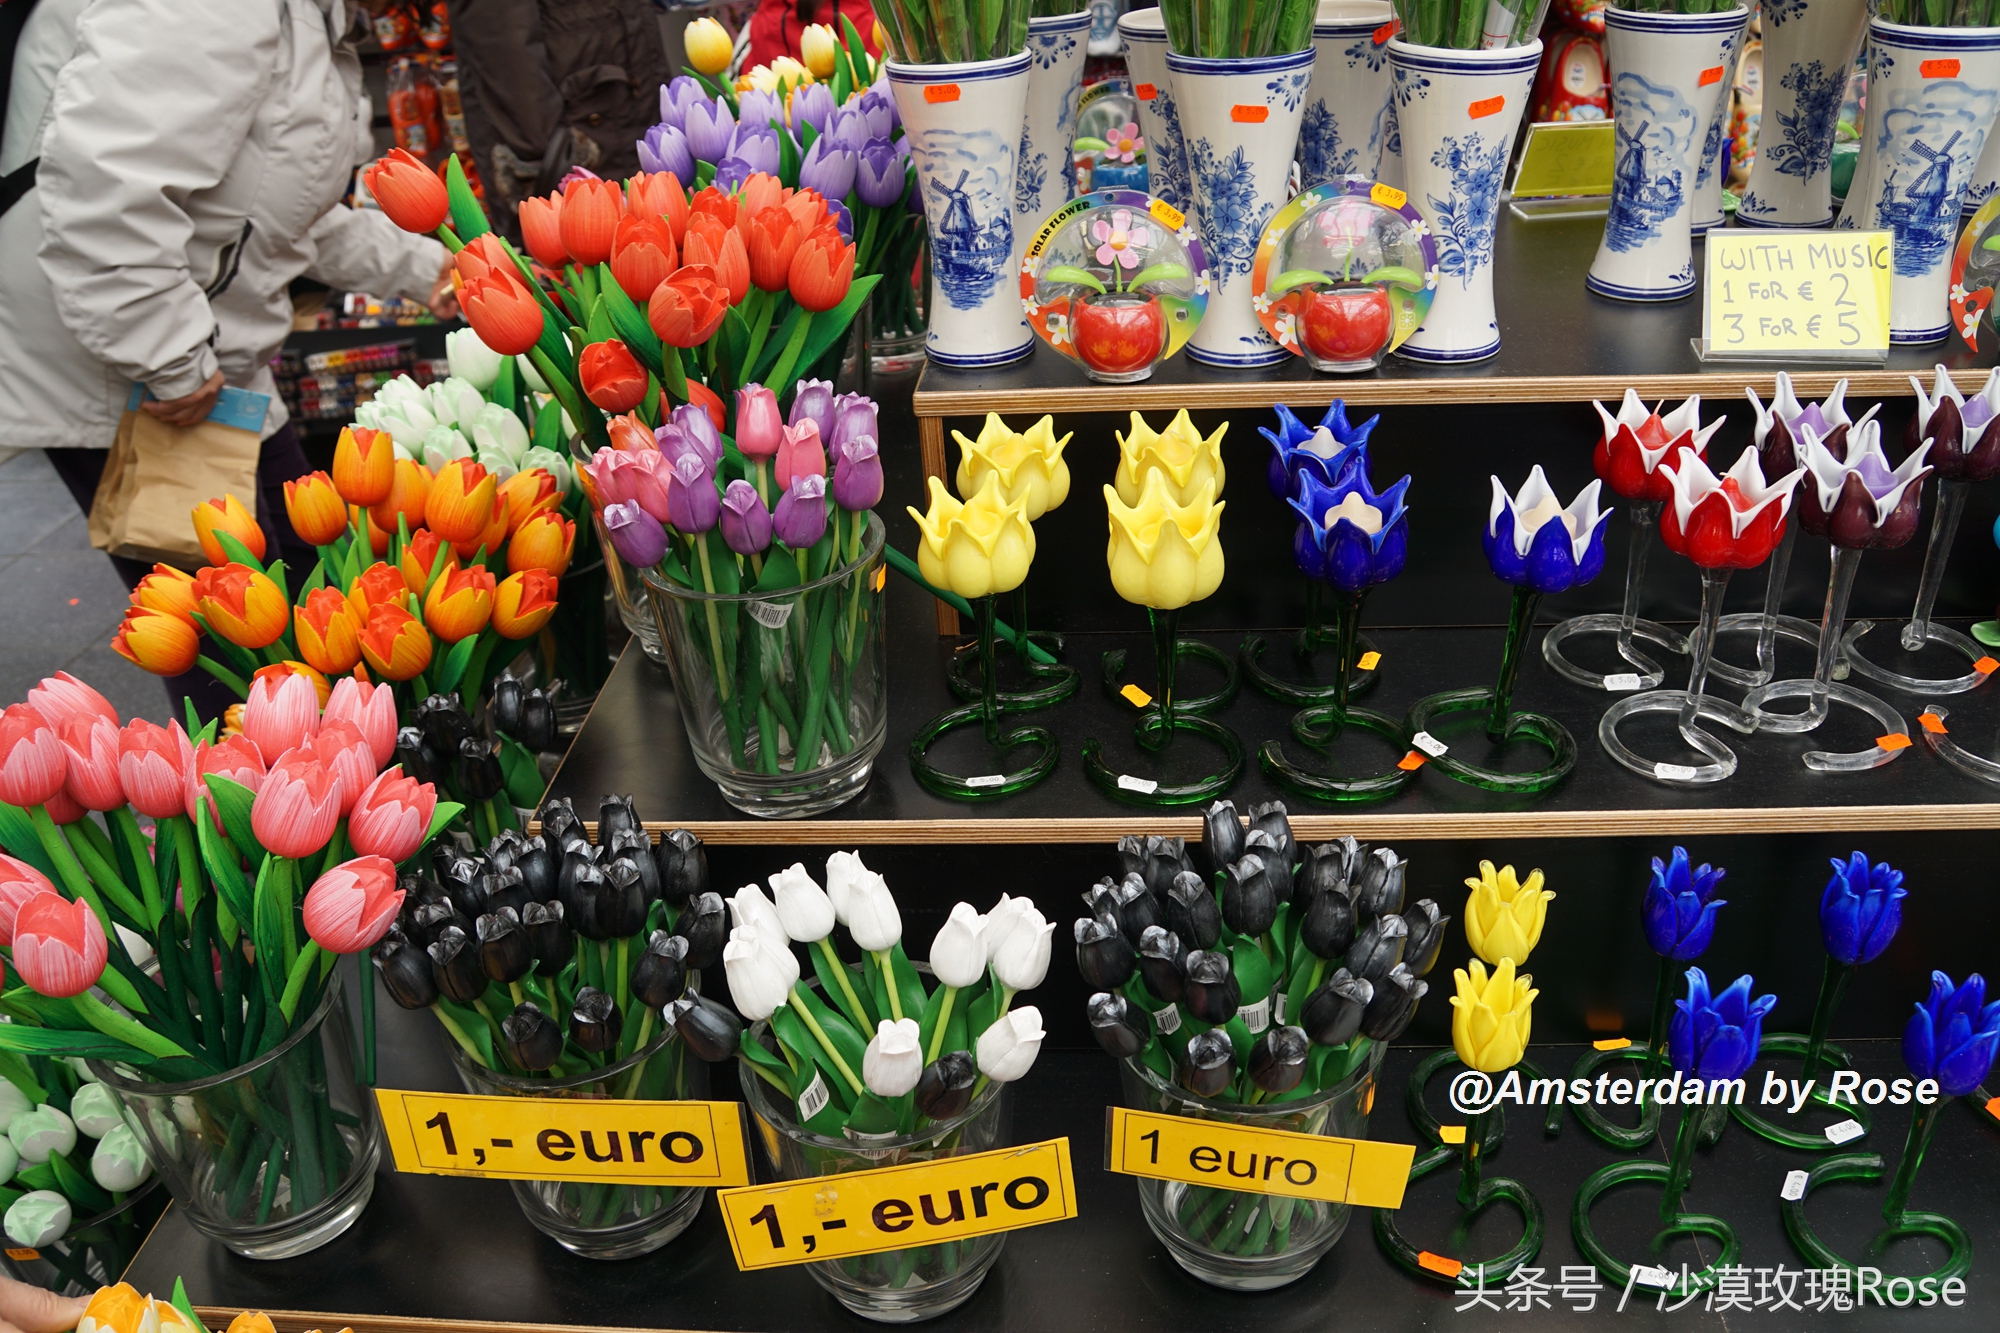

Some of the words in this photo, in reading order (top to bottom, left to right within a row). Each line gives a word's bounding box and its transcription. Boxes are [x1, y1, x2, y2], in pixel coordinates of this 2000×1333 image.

[1937, 61, 1957, 69] 5.00
[1082, 85, 1111, 104] FLOWER
[1246, 107, 1264, 115] 5.00
[1484, 98, 1501, 108] 5.00
[1030, 228, 1052, 257] SOLAR
[1049, 201, 1090, 229] FLOWER
[1720, 245, 1794, 272] WITH
[1808, 242, 1888, 270] MUSIC
[1723, 280, 1734, 303] 1
[1797, 281, 1814, 301] €
[1830, 273, 1857, 306] 2
[1722, 314, 1745, 344] 3
[1806, 314, 1822, 338] €
[1838, 310, 1861, 346] 5
[536, 1126, 704, 1164] euro
[1140, 1129, 1159, 1164] 1
[1189, 1145, 1317, 1186] euro
[870, 1176, 1050, 1234] euro
